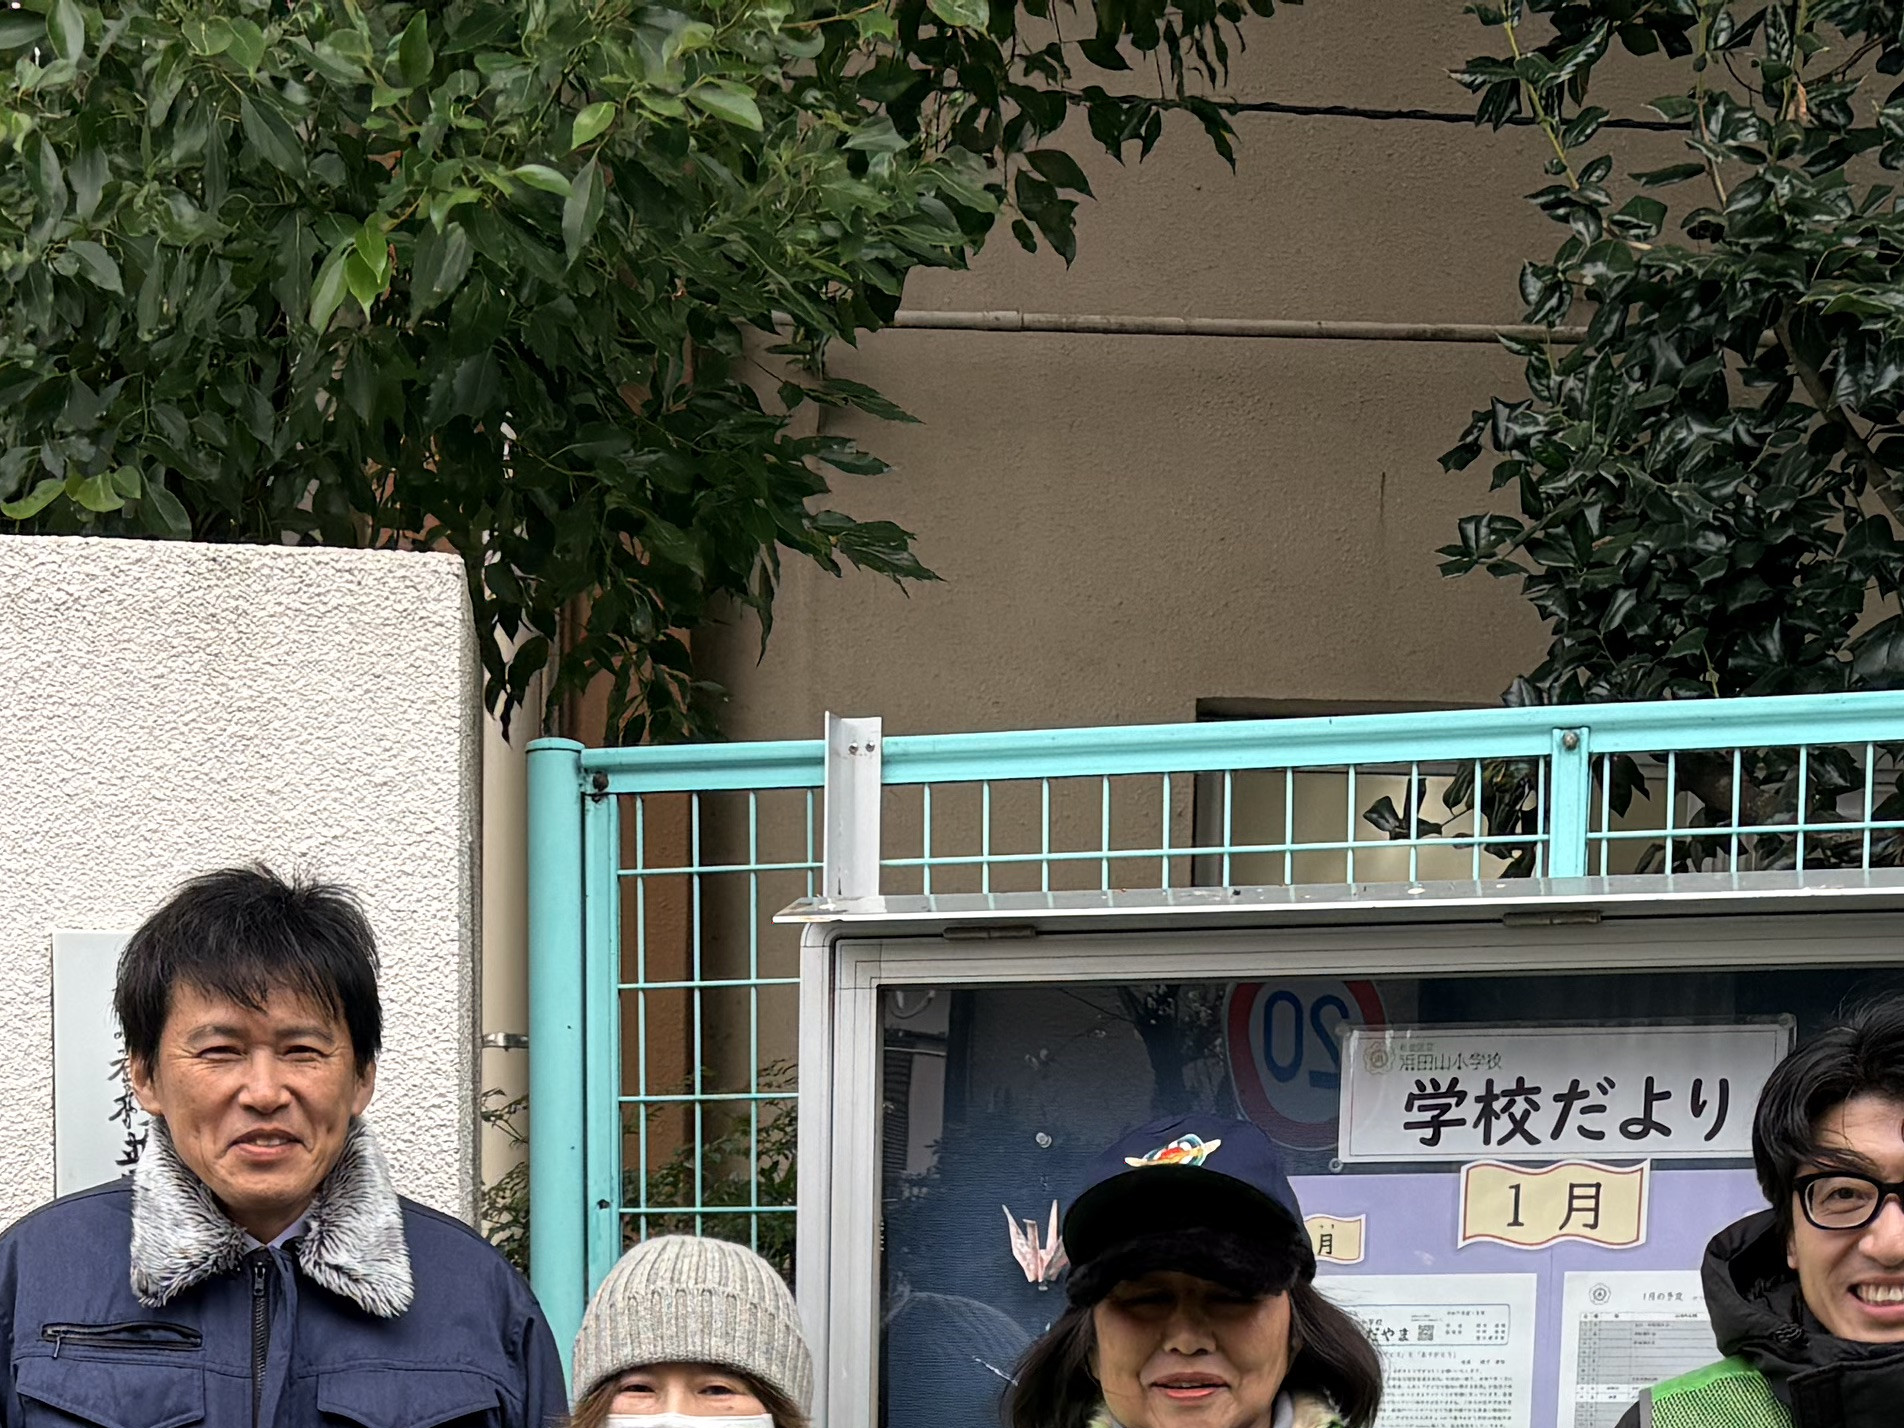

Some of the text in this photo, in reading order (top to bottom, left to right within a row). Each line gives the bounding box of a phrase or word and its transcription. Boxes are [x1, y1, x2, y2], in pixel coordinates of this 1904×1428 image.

[1402, 1076, 1730, 1147] 学校だより
